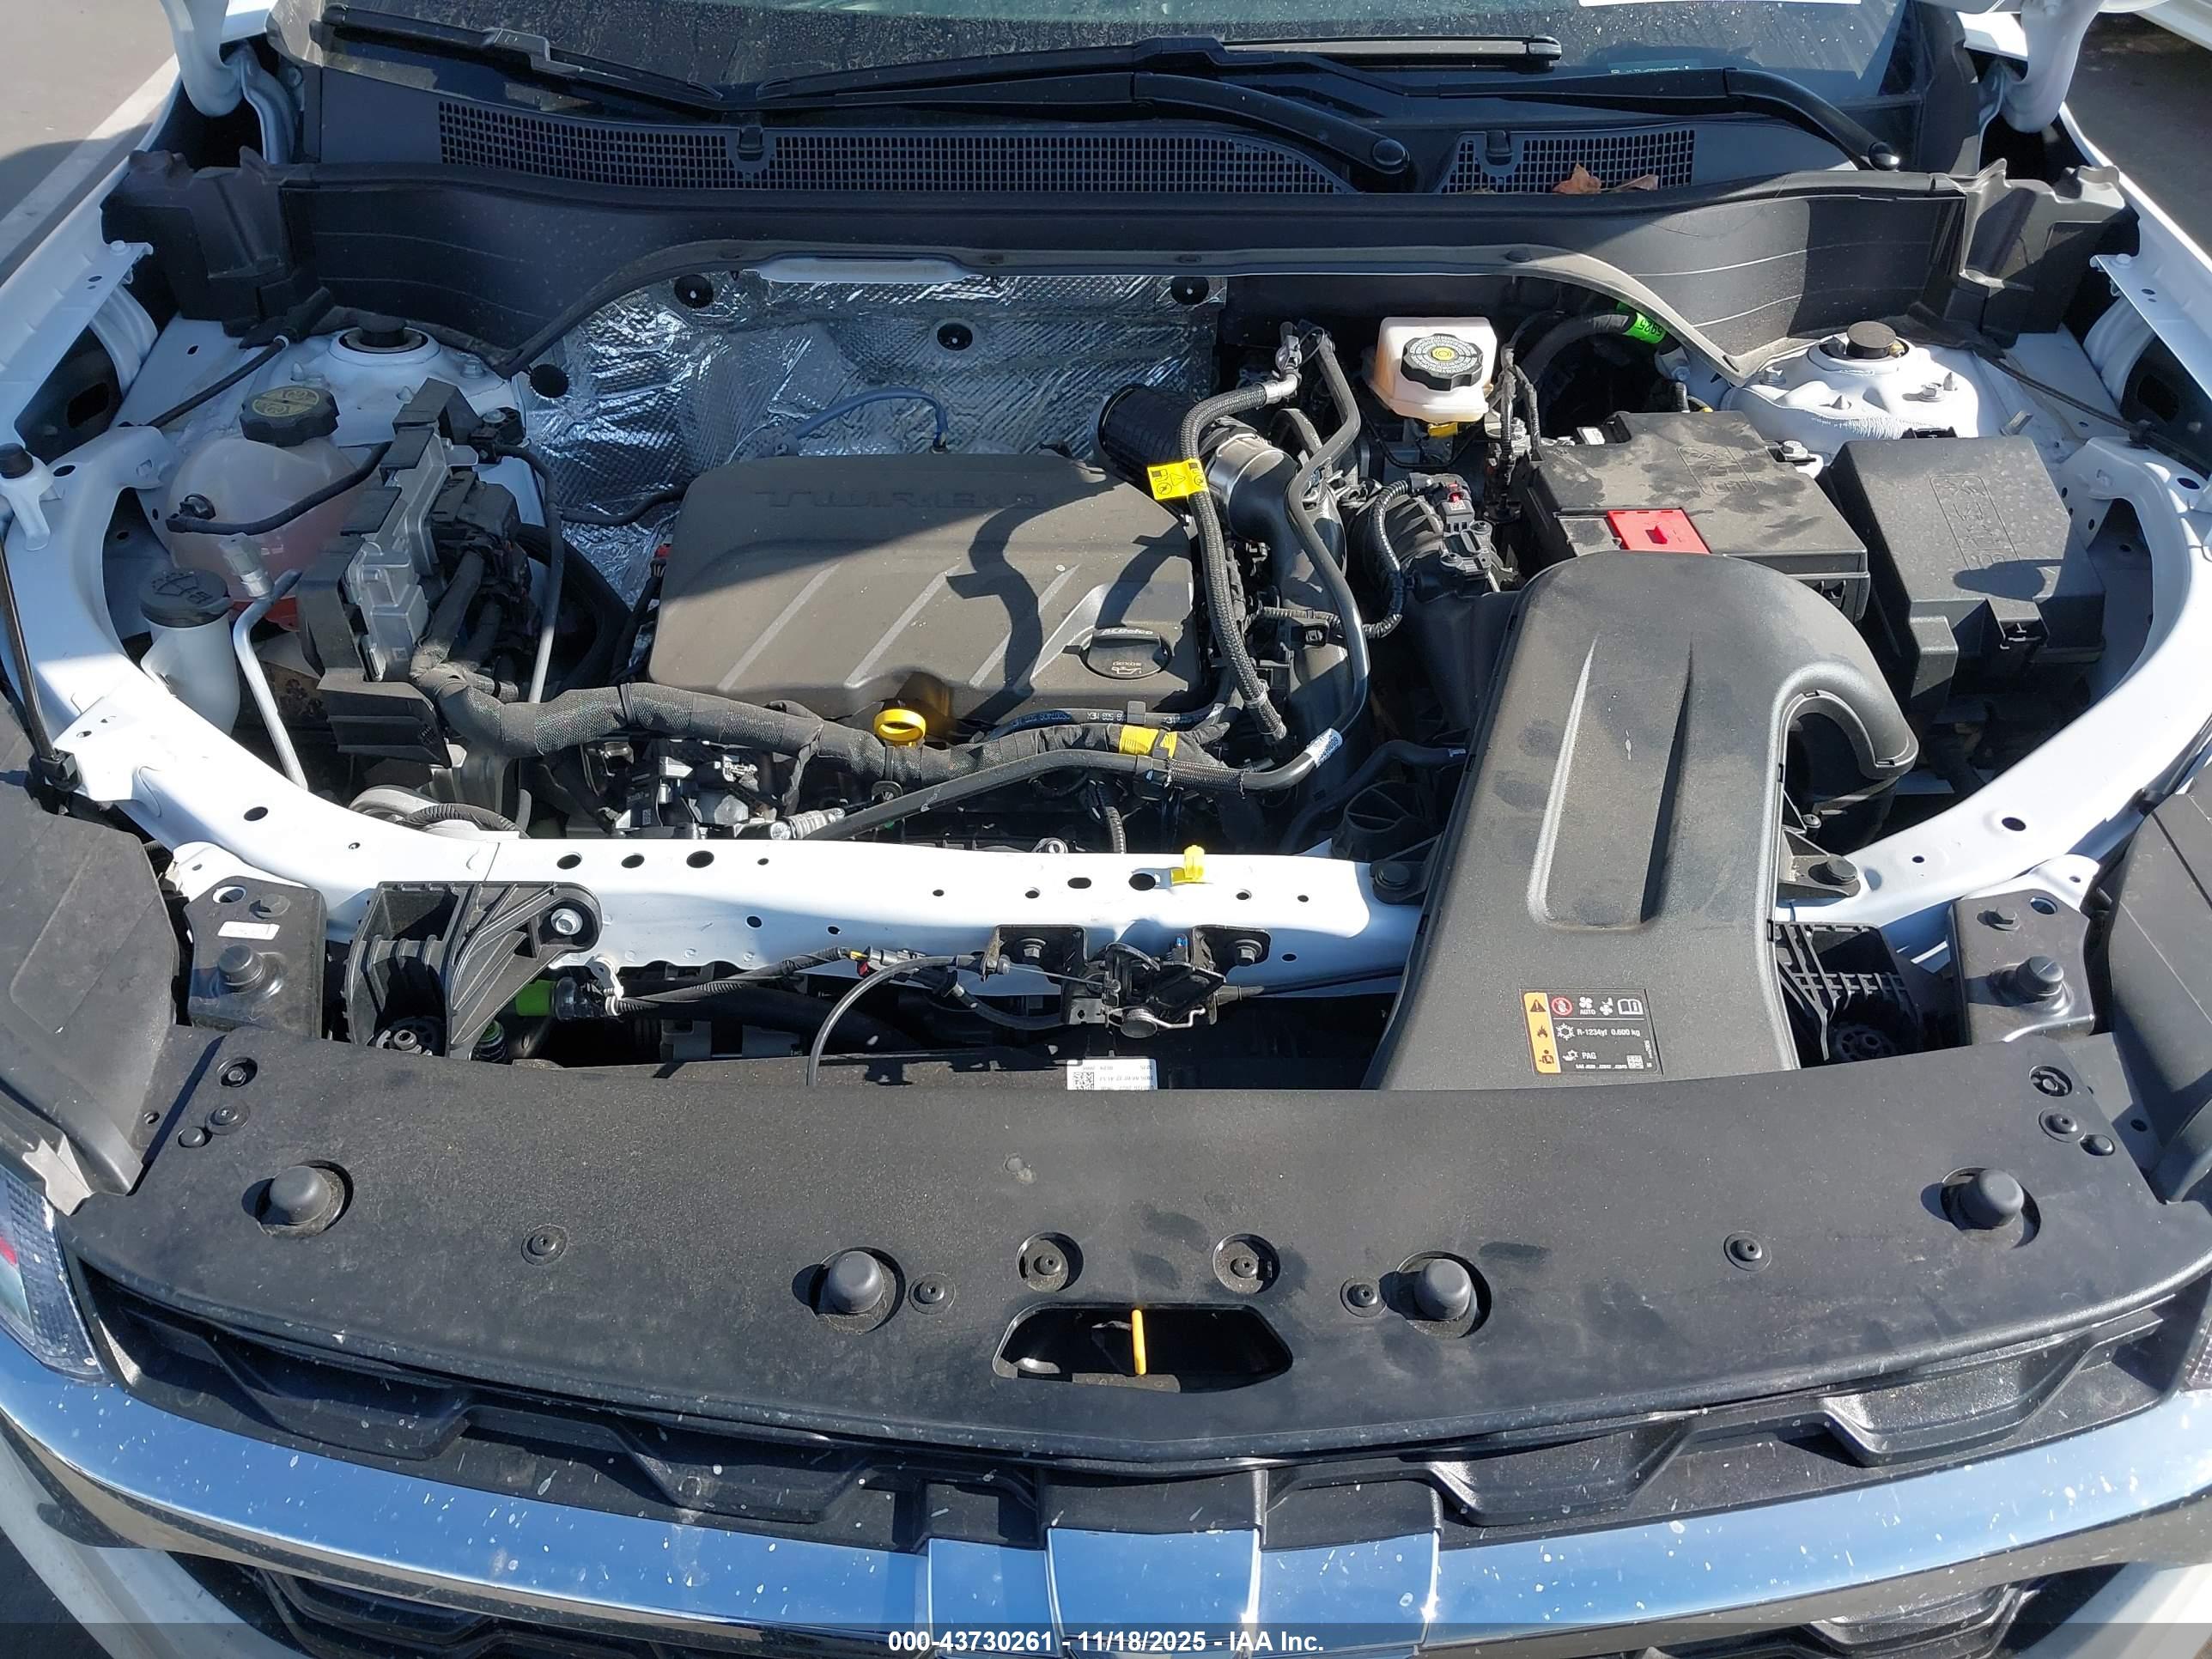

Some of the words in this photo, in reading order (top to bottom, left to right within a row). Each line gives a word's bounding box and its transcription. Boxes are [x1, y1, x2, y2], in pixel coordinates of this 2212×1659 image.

[1634, 319, 1663, 336] 5925
[1577, 1028, 1608, 1037] R-1234yf
[1631, 1028, 1641, 1037] kg
